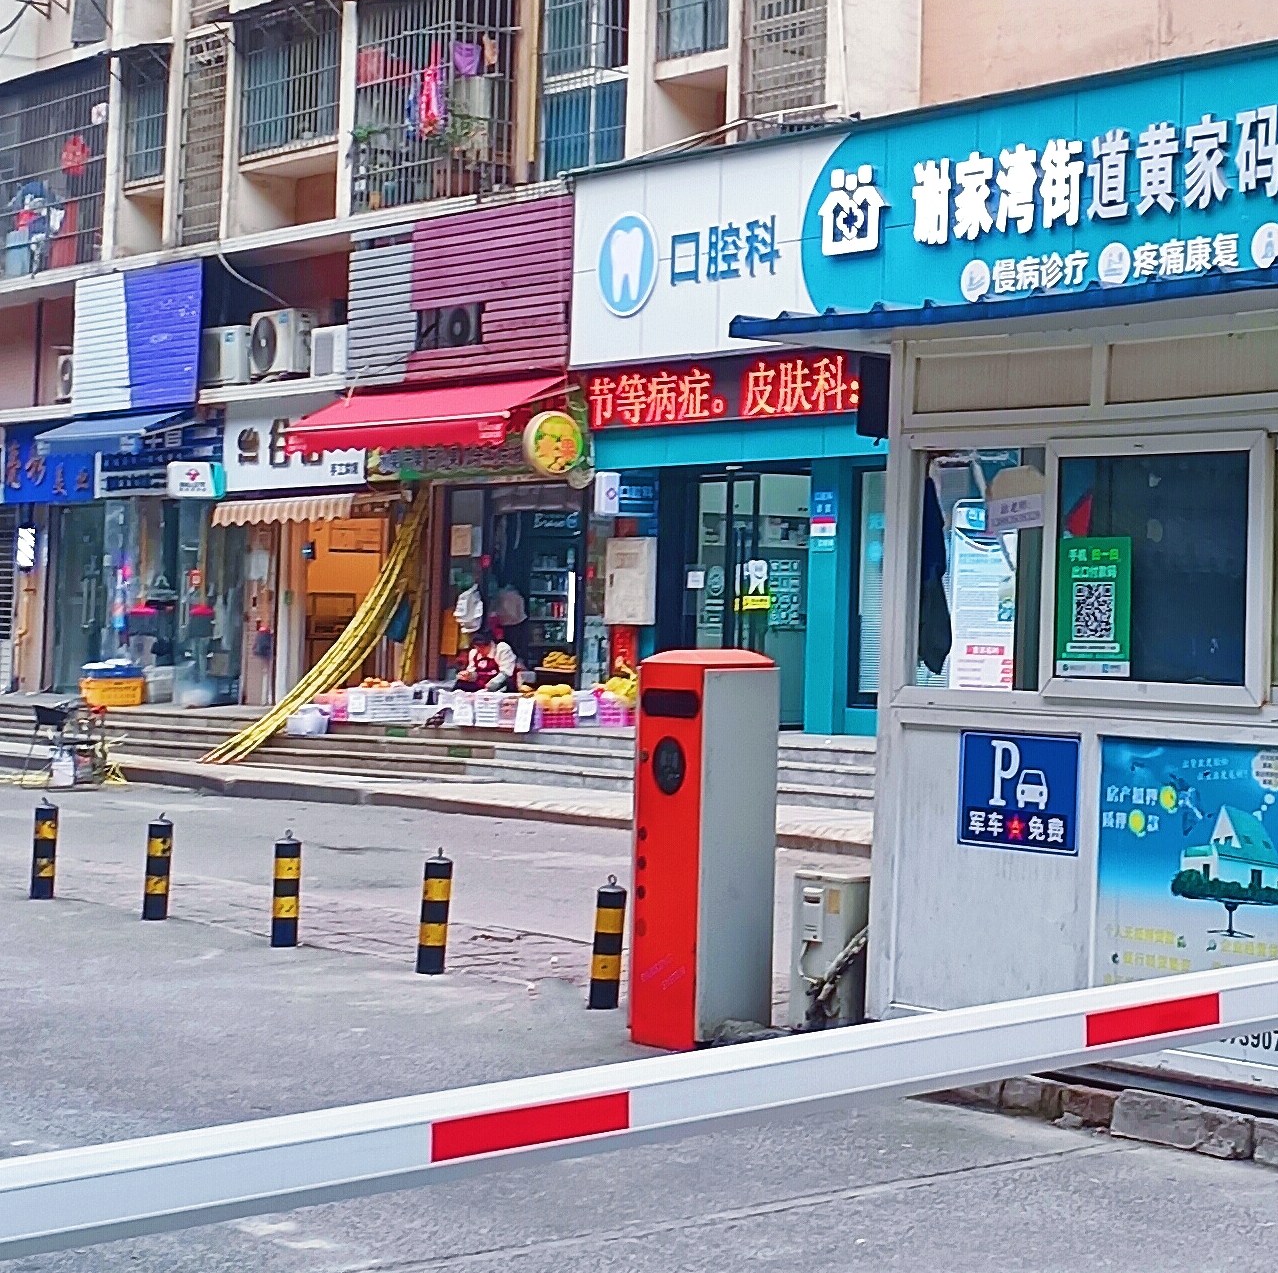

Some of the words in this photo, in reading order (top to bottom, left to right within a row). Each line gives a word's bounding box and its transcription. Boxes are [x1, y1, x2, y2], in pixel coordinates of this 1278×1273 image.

[669, 215, 782, 287] 口腔科
[992, 249, 1089, 294] 慢病诊疗
[1132, 231, 1240, 278] 疼痛康复
[988, 739, 1021, 806] P
[968, 810, 1004, 837] 军车
